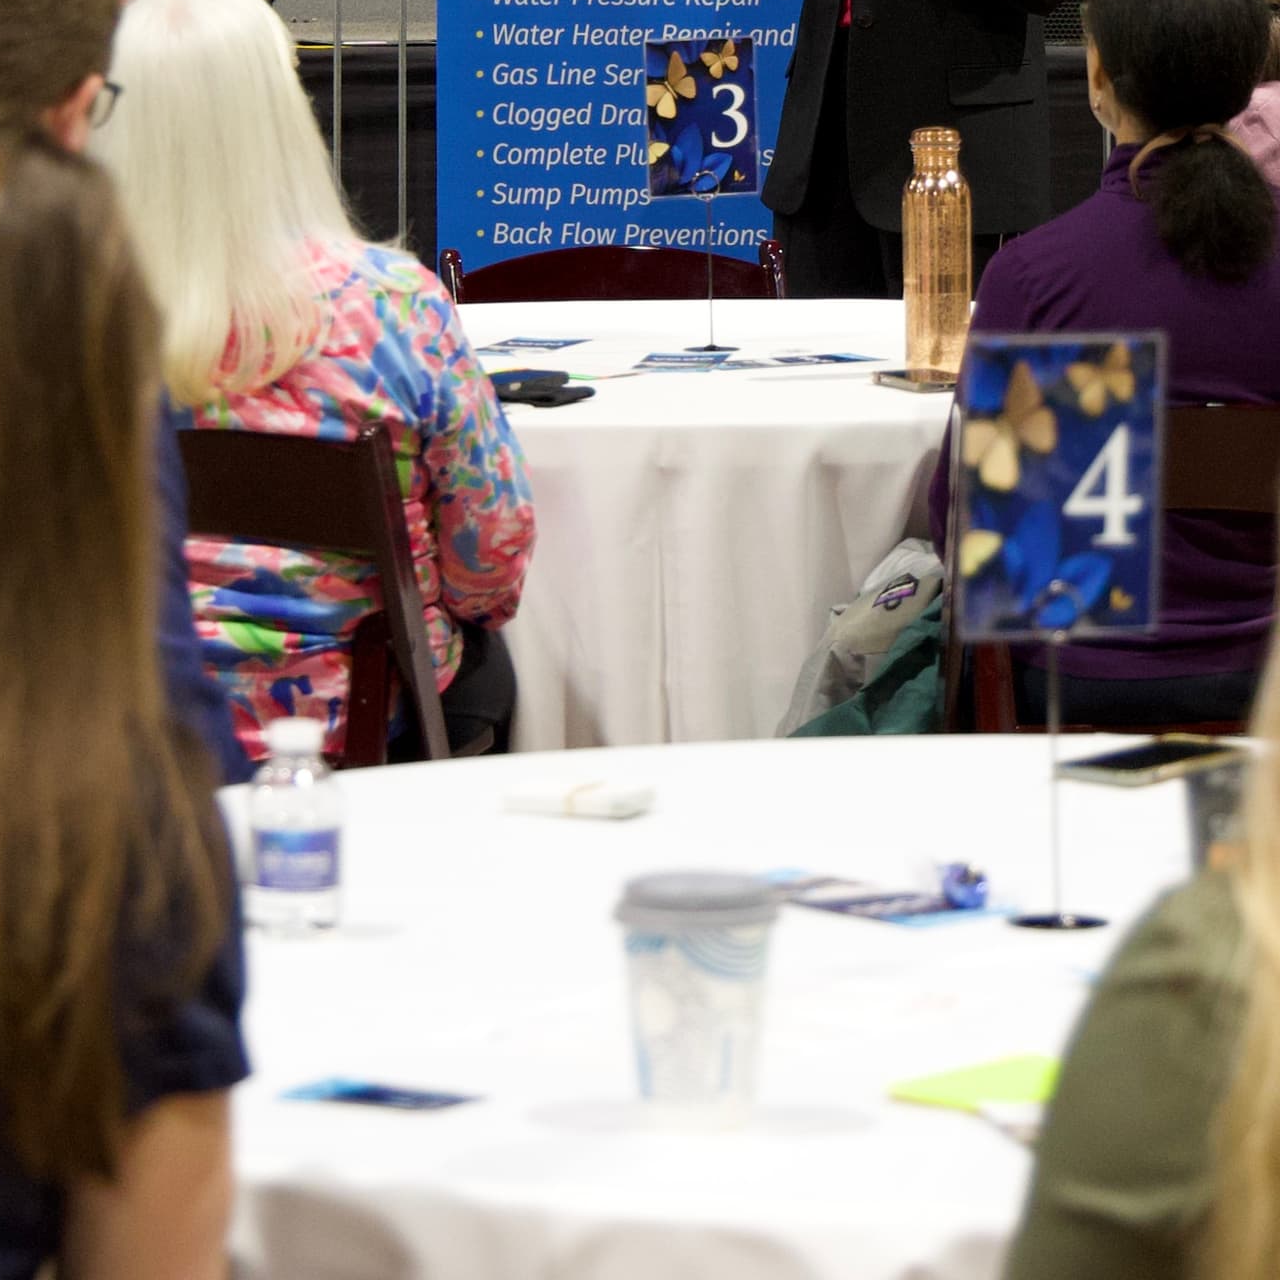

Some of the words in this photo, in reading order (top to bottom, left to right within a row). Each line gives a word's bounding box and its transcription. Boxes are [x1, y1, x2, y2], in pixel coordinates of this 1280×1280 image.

[493, 23, 565, 46] Water
[572, 23, 658, 48] Heater
[749, 22, 796, 47] and
[492, 62, 538, 86] Gas
[546, 61, 597, 86] Line
[603, 63, 645, 86] Ser
[492, 102, 593, 132] Clogged
[710, 82, 750, 149] 3
[492, 142, 608, 171] Complete
[491, 182, 562, 211] Sump
[570, 183, 653, 211] Pumps
[493, 221, 553, 245] Back
[562, 221, 617, 245] Flow
[623, 222, 768, 247] Preventions
[1061, 421, 1145, 547] 4
